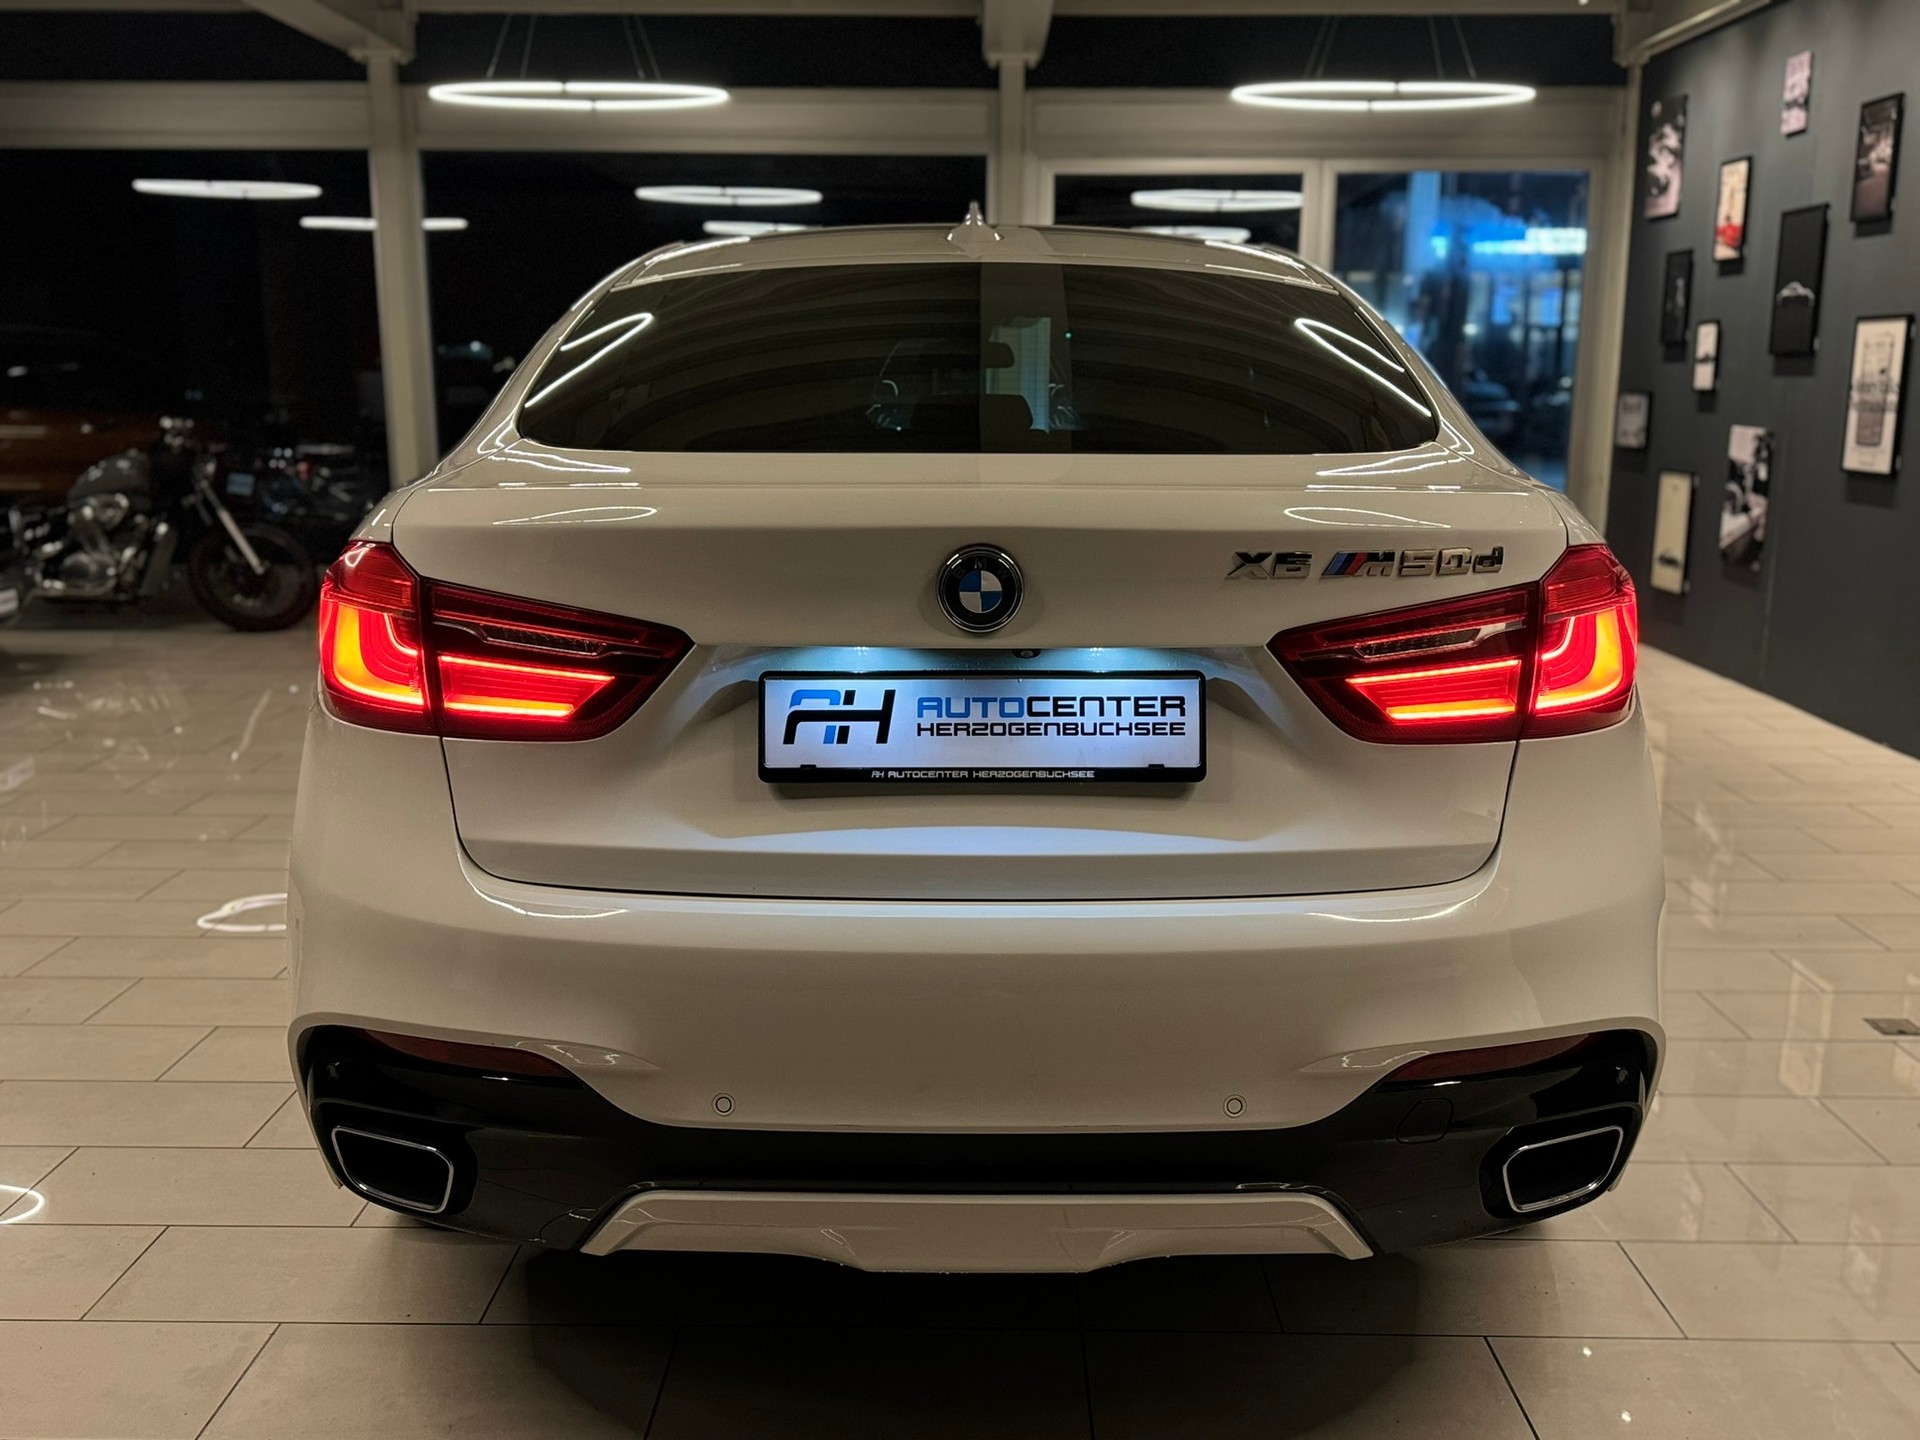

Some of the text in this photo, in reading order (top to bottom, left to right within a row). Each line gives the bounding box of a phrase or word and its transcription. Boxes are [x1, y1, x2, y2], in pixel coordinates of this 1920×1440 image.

[951, 558, 1011, 580] BMW
[1225, 550, 1313, 579] X6
[916, 695, 1187, 718] AUTOCENTER
[916, 721, 1187, 737] HERZOGENBUCHSEE
[888, 770, 969, 779] AUTOCENTER
[972, 770, 1095, 779] HERZOGENBUCHSEE
